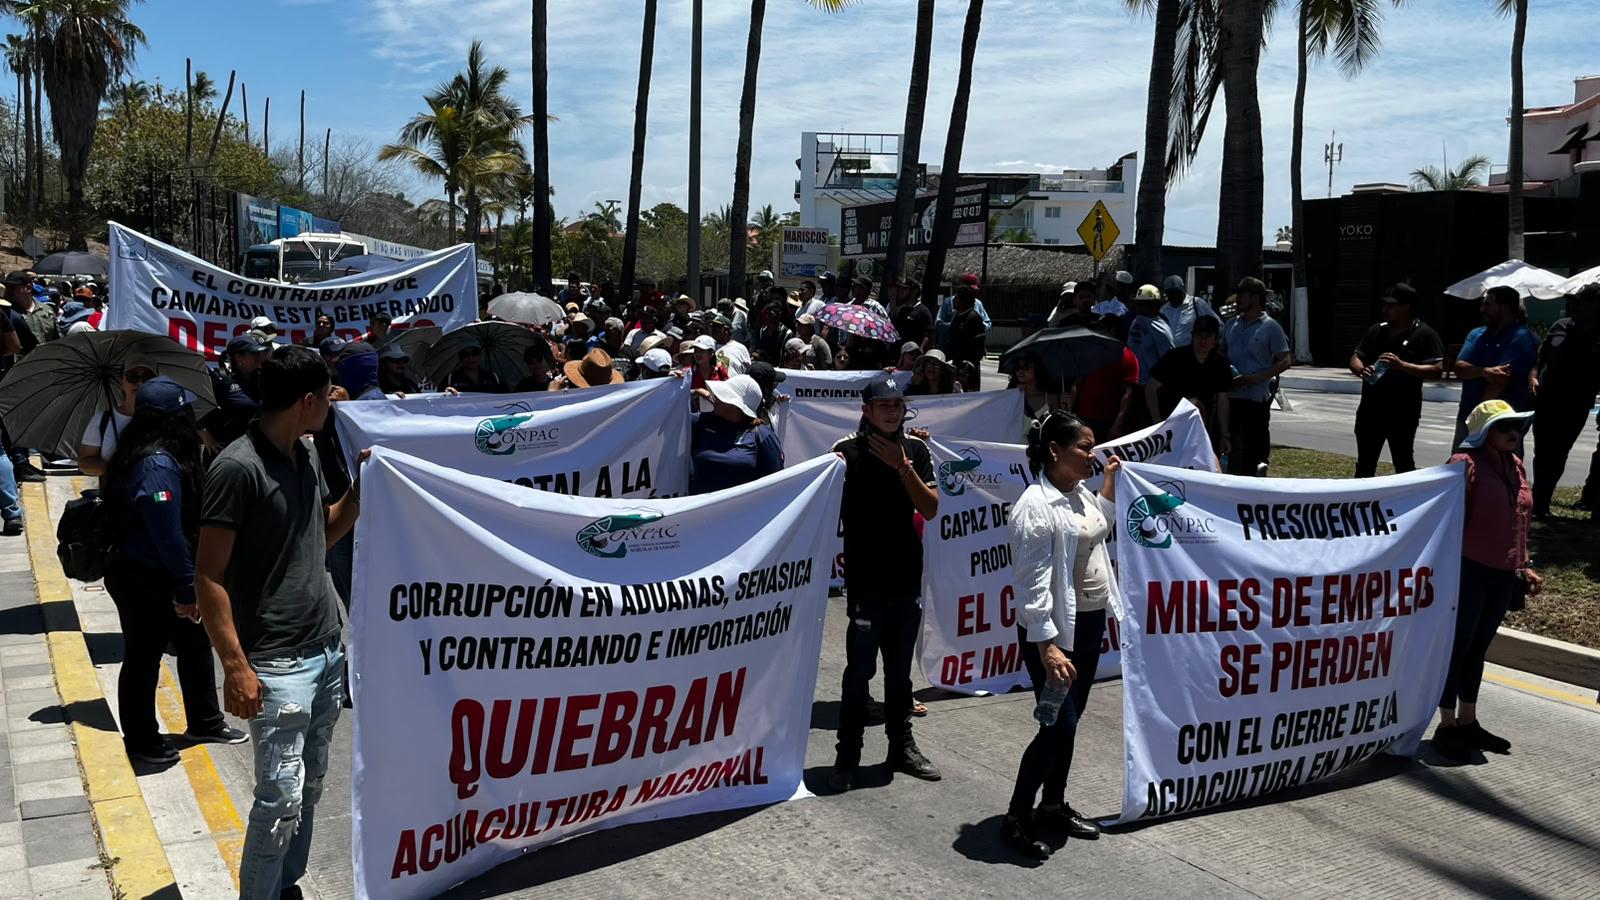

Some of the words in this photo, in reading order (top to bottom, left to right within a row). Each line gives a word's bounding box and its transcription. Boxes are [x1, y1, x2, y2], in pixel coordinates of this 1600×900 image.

[784, 230, 827, 244] MARISCOS
[1340, 224, 1373, 236] YOKO
[151, 287, 266, 320] CAMARÓN
[335, 293, 454, 324] GENERANDO
[192, 270, 217, 290] EL
[227, 279, 389, 303] CONTRABANDO
[393, 276, 418, 292] DE
[594, 465, 613, 498] A
[621, 456, 651, 495] LA
[940, 505, 989, 541] CAPAZ
[990, 502, 1012, 529] DE
[1237, 500, 1398, 541] PRESIDENTA:
[389, 578, 574, 622] CORRUPCIÓN
[580, 586, 614, 618] EN
[620, 575, 730, 617] ADUANAS,
[735, 557, 813, 602] SENASICA
[1146, 577, 1262, 635] MILES
[1271, 576, 1313, 629] DE
[957, 592, 991, 637] EL
[419, 638, 432, 676] Y
[439, 632, 642, 672] CONTRABANDO
[646, 630, 663, 661] E
[666, 601, 793, 659] IMPORTACIÓN
[940, 650, 976, 686] DE
[1219, 643, 1262, 698] SE
[1269, 630, 1394, 693] PIERDEN
[449, 666, 748, 800] QUIEBRAN
[1177, 720, 1232, 765] CON
[1236, 717, 1262, 756] EL
[1270, 703, 1350, 750] CIERRE
[1351, 698, 1380, 735] DE
[1379, 689, 1398, 729] LA
[1140, 754, 1300, 819] ACUACULTURA
[1306, 748, 1340, 782] EN
[391, 784, 630, 880] ACUACULTURA
[630, 746, 769, 807] NACIONAL
